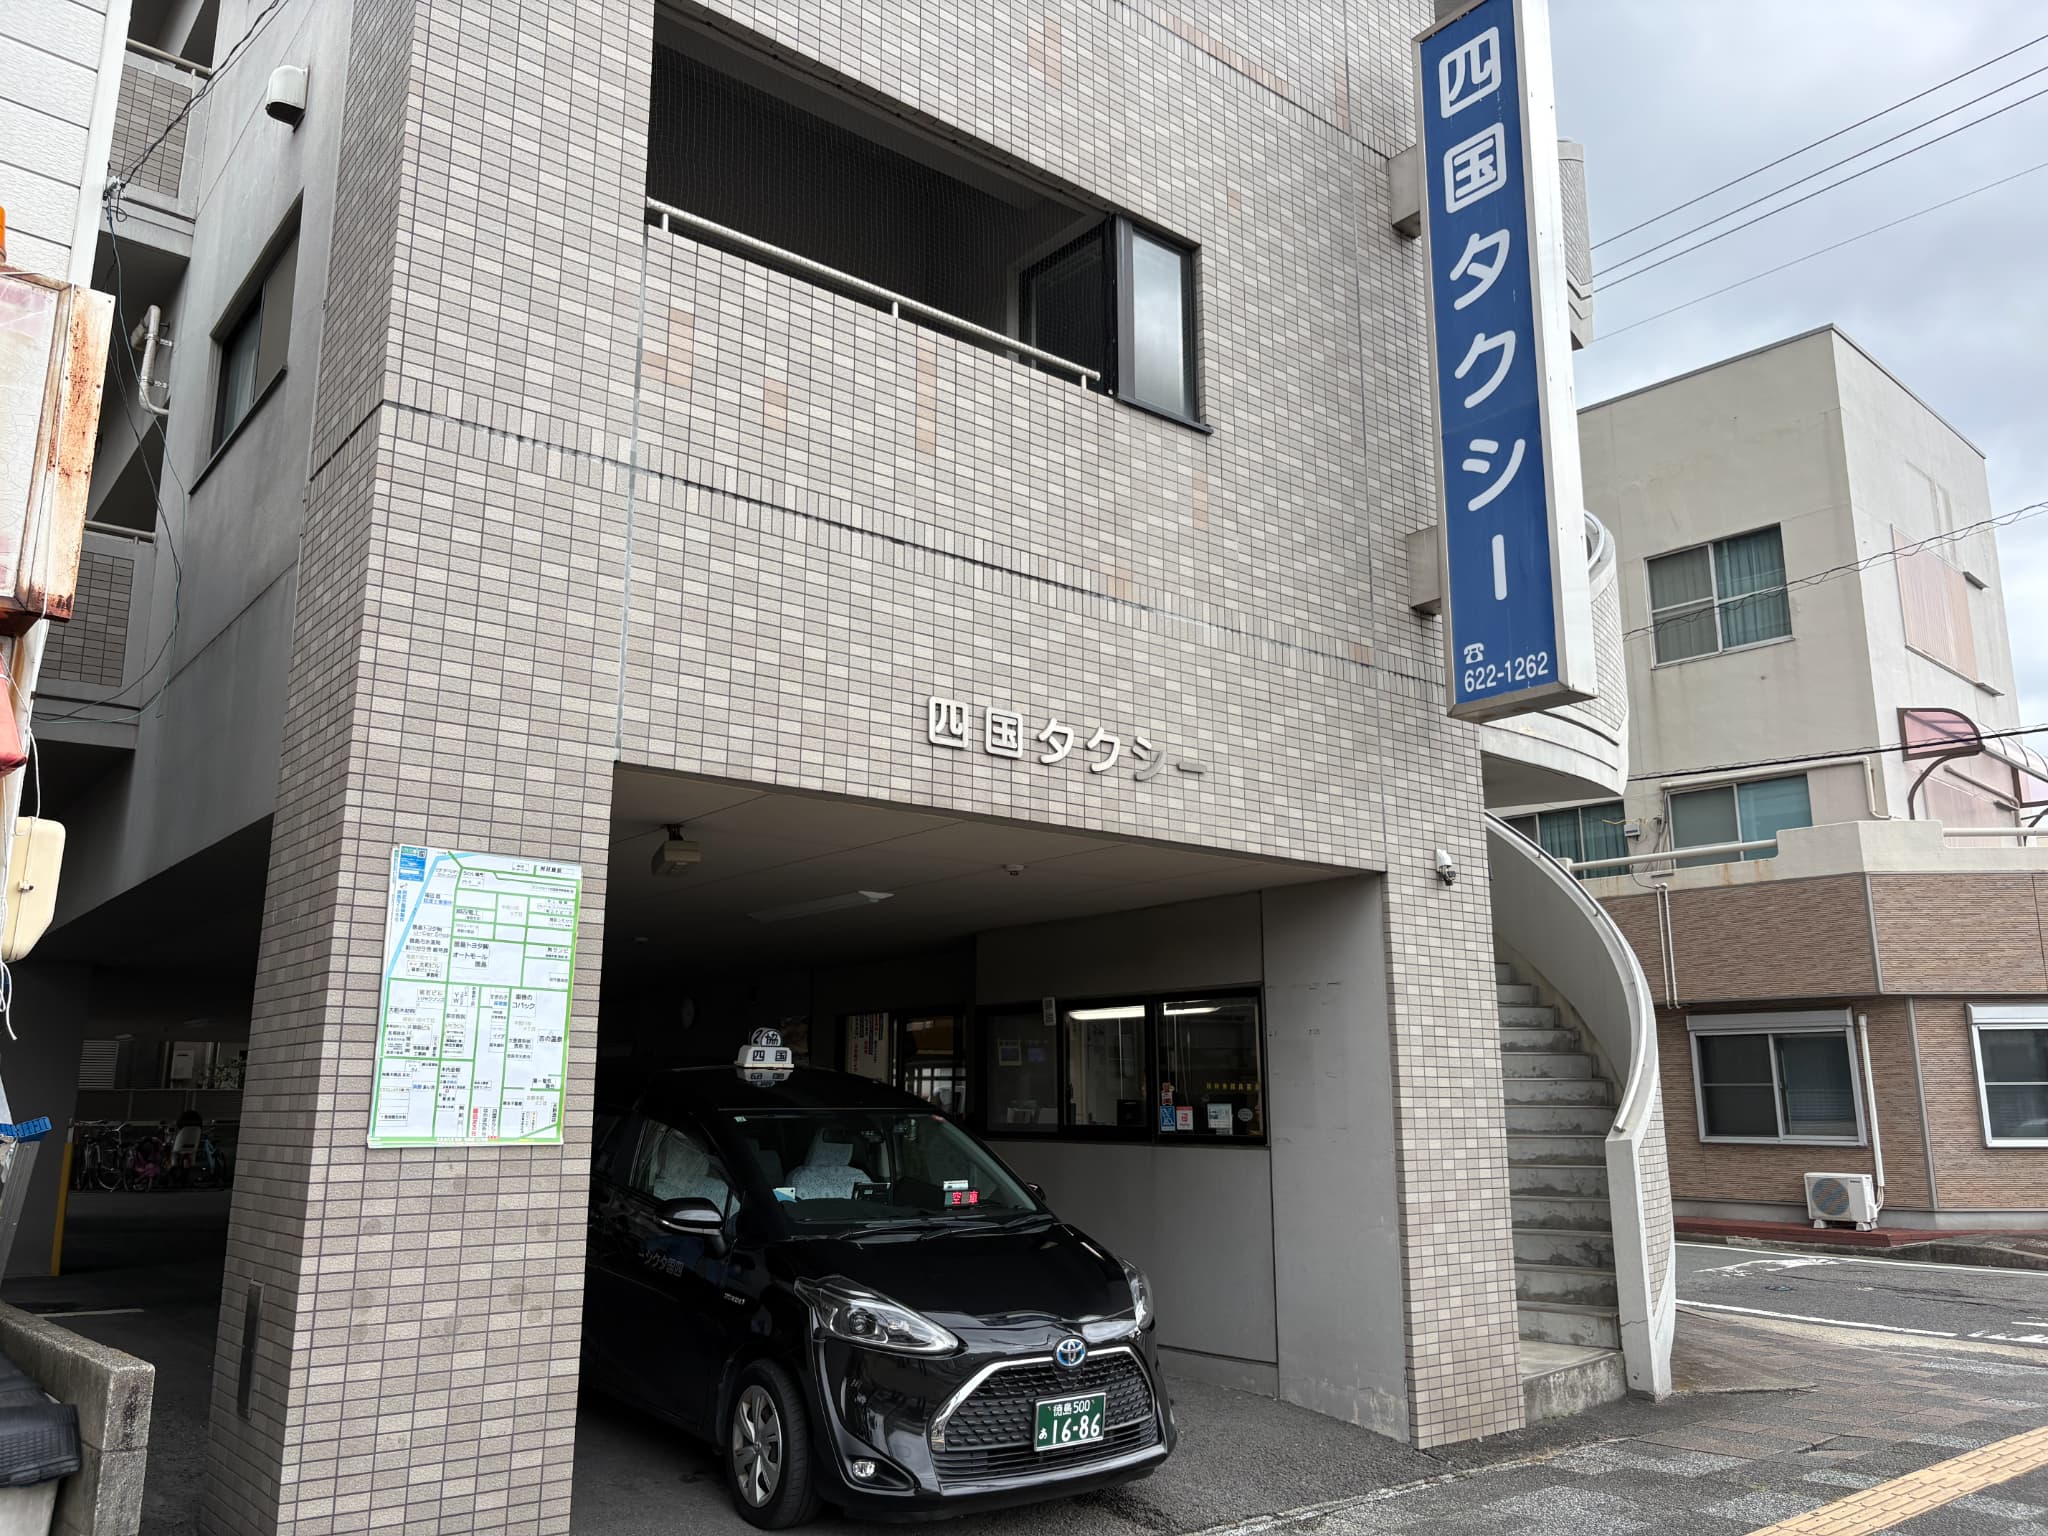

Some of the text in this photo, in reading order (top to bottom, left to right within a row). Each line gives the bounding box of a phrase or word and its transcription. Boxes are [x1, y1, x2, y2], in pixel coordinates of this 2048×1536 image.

[1438, 26, 1526, 601] 四国タクシー
[1463, 651, 1549, 694] 622-1262
[928, 695, 1208, 782] 四国タクシー
[752, 1050, 788, 1062] 四国
[952, 1190, 979, 1205] 空車
[1052, 1413, 1101, 1445] 16-86
